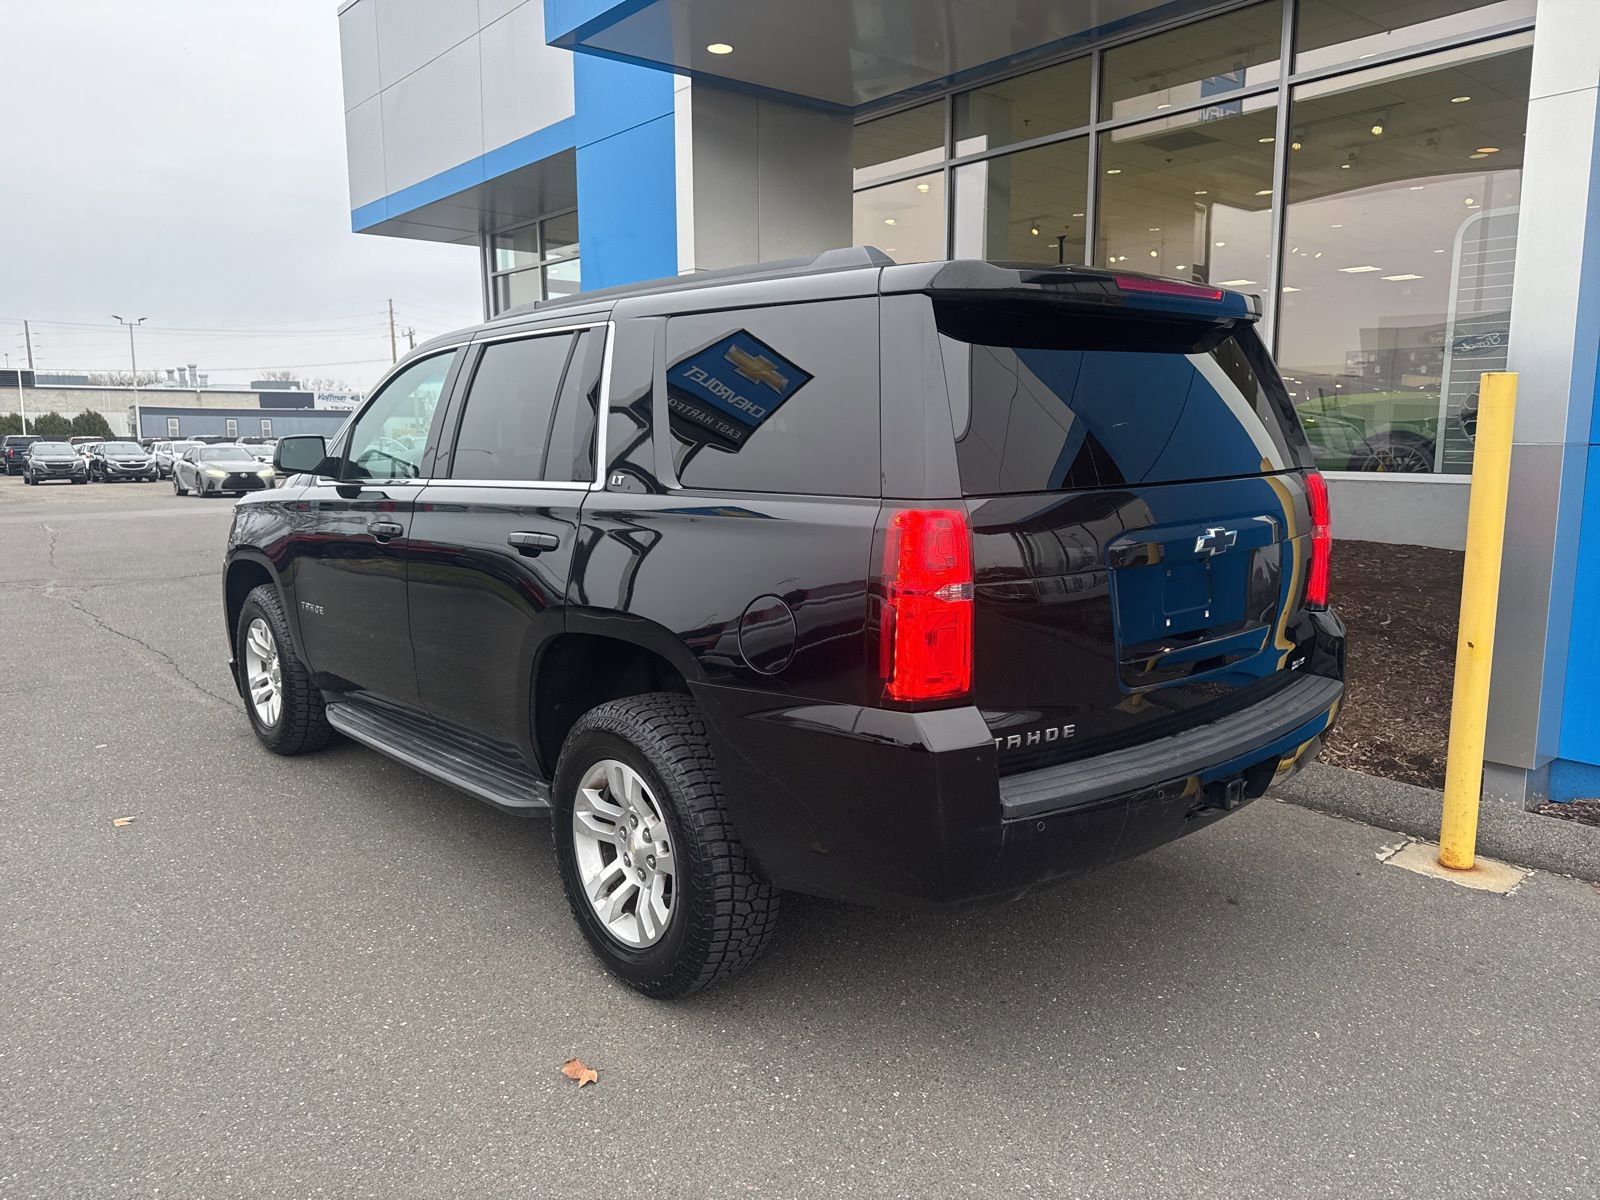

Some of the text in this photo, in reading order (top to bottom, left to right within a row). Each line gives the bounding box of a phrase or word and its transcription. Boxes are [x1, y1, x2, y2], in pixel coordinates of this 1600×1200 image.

[611, 475, 625, 485] LT
[300, 601, 325, 615] TAHOE
[994, 724, 1076, 752] TAHOE
